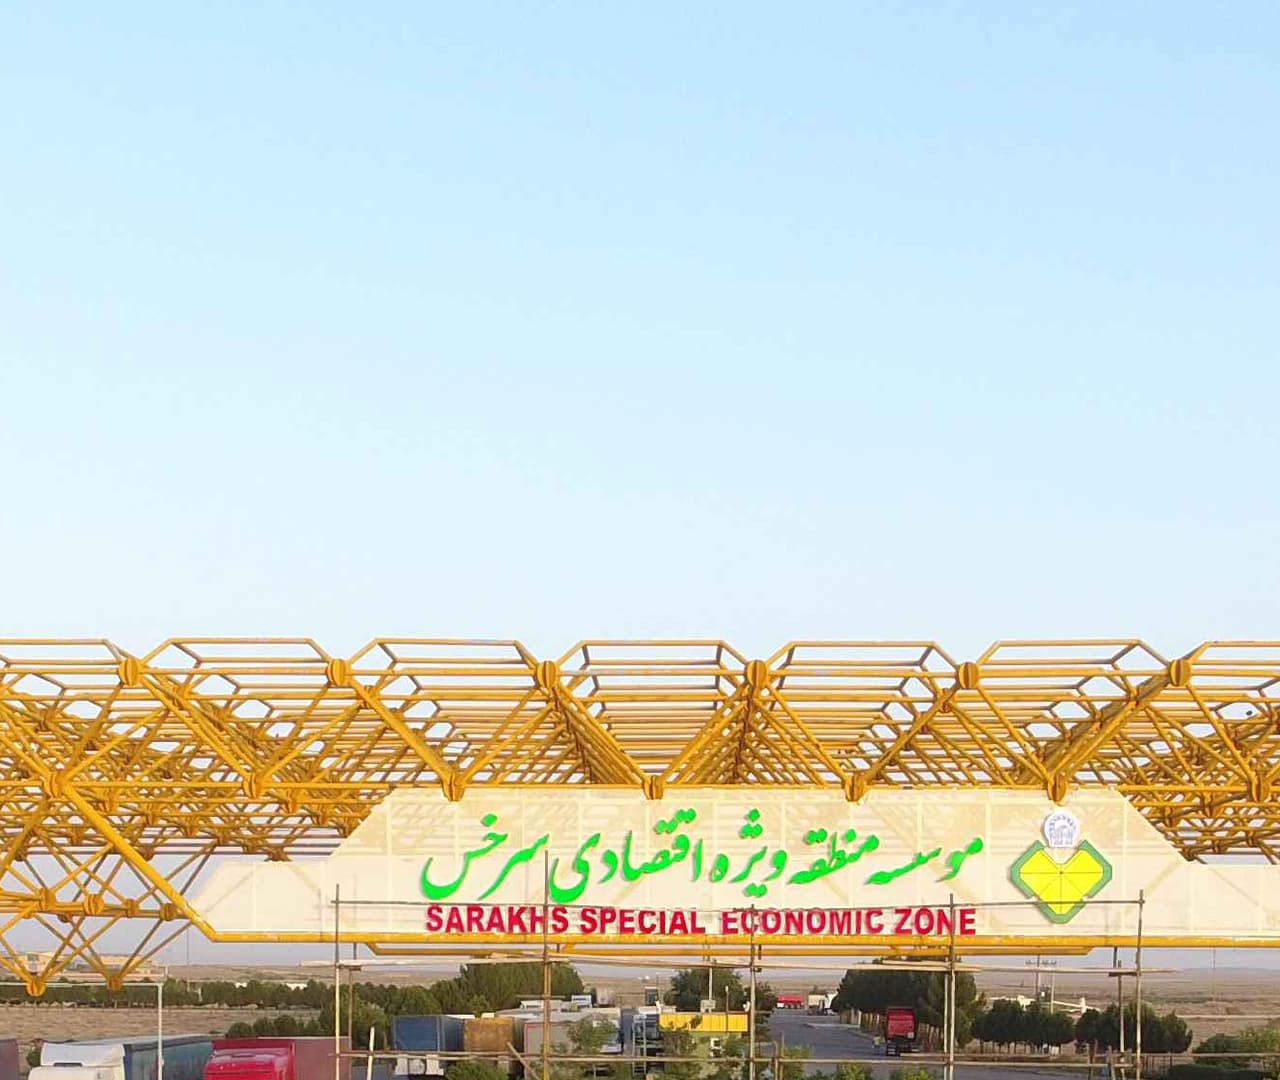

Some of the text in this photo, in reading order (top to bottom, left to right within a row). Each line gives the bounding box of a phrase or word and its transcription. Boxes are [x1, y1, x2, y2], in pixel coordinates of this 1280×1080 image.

[419, 807, 985, 905] موسسه منطقه ویژه اقتصادی سرخس
[425, 903, 977, 936] SARAKHS SPECIAL ECONOMIC ZONE
